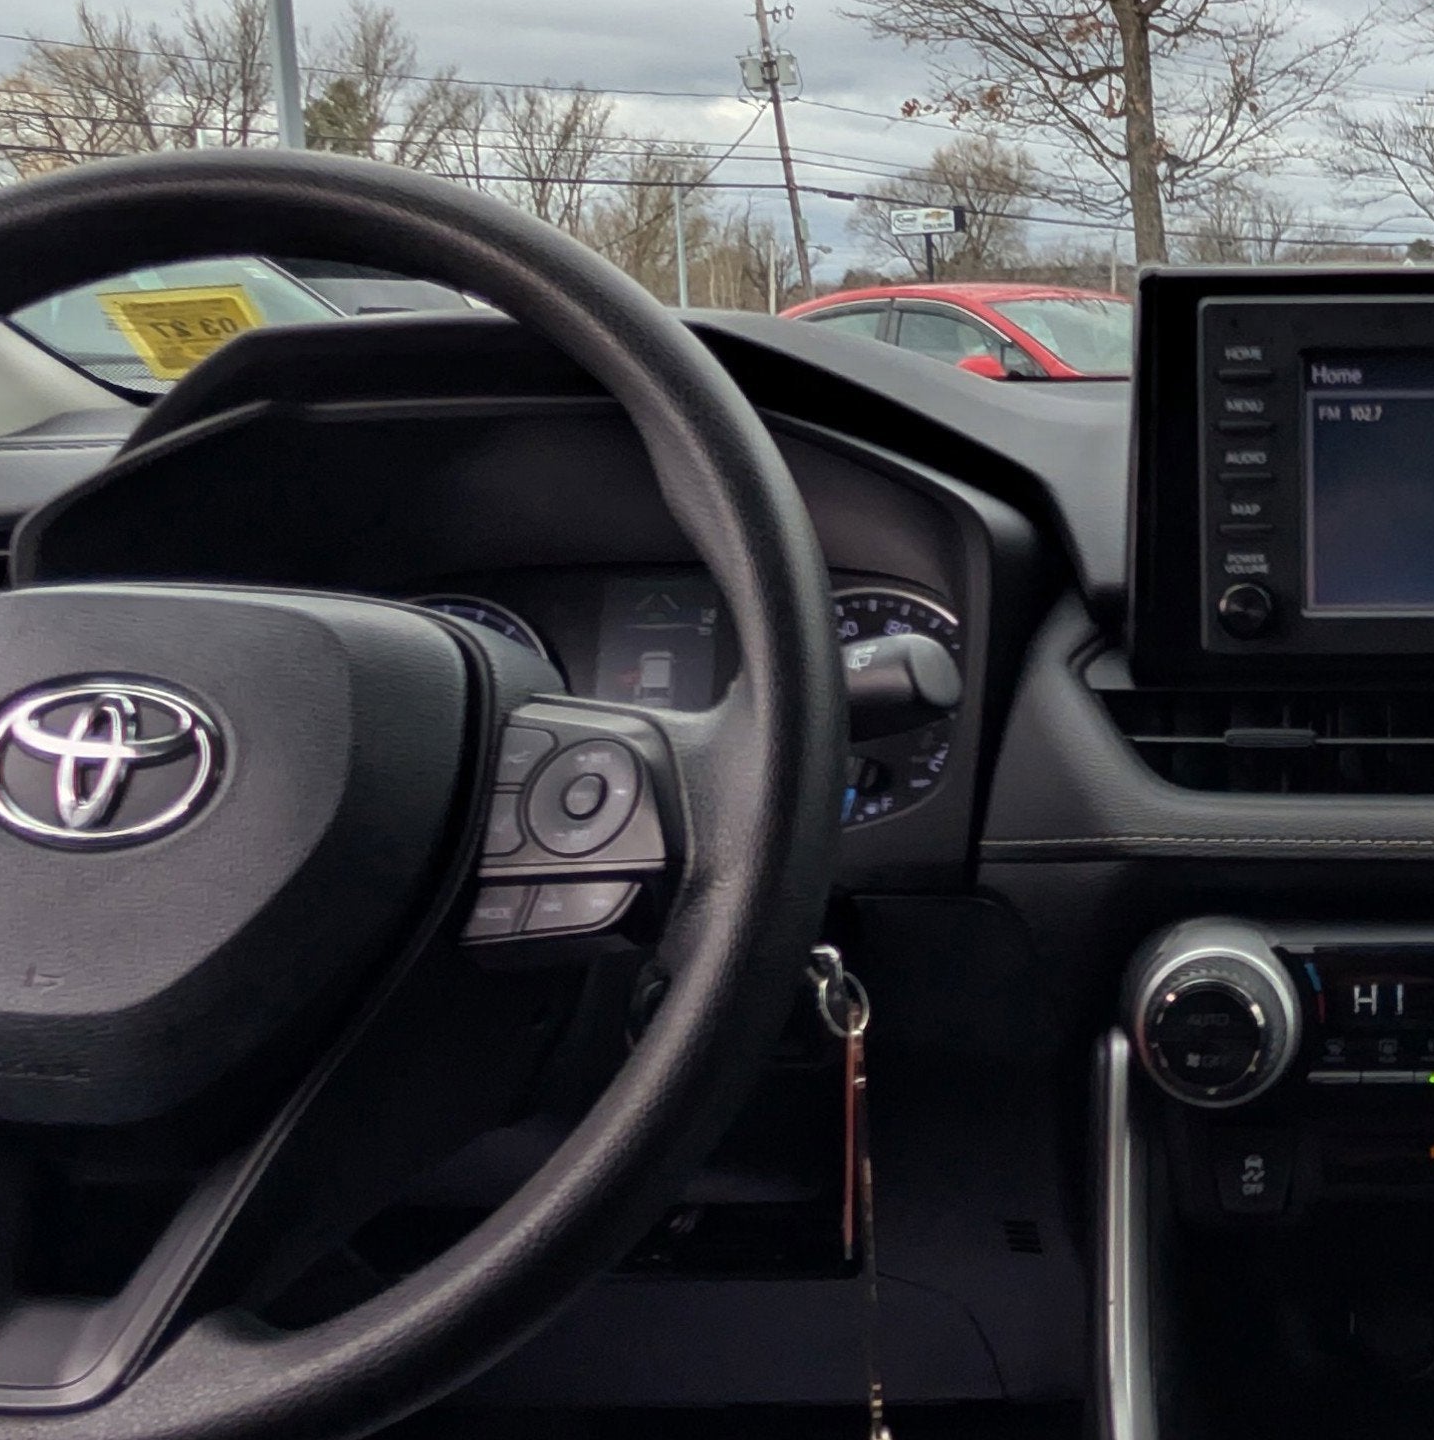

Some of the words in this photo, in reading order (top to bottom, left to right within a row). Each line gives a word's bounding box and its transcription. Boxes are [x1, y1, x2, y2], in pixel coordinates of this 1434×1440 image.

[1311, 364, 1364, 385] Home
[1318, 405, 1342, 422] FM
[1224, 451, 1268, 465] AUDIO
[1229, 502, 1262, 516] MAP
